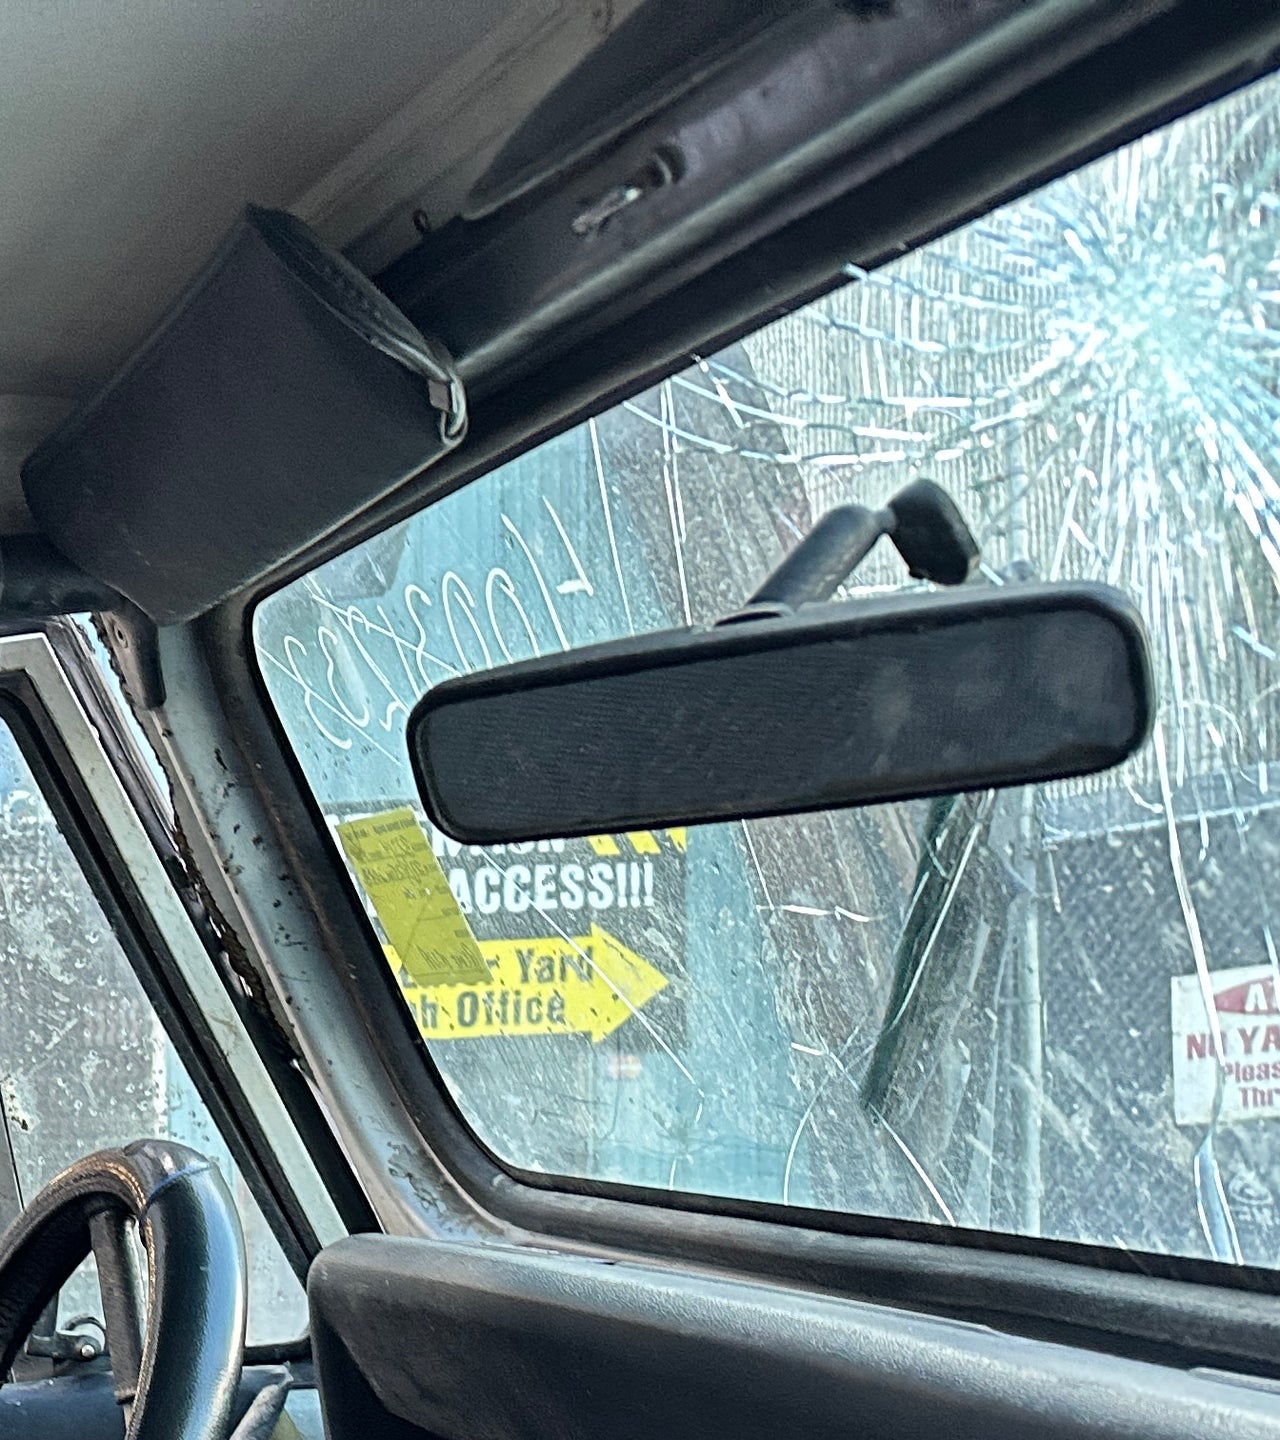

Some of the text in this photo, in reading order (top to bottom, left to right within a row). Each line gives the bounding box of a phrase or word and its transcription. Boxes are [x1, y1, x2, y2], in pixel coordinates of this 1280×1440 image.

[448, 862, 655, 915] ACCESS!!!
[515, 946, 595, 985] Yard
[457, 988, 566, 1028] Office
